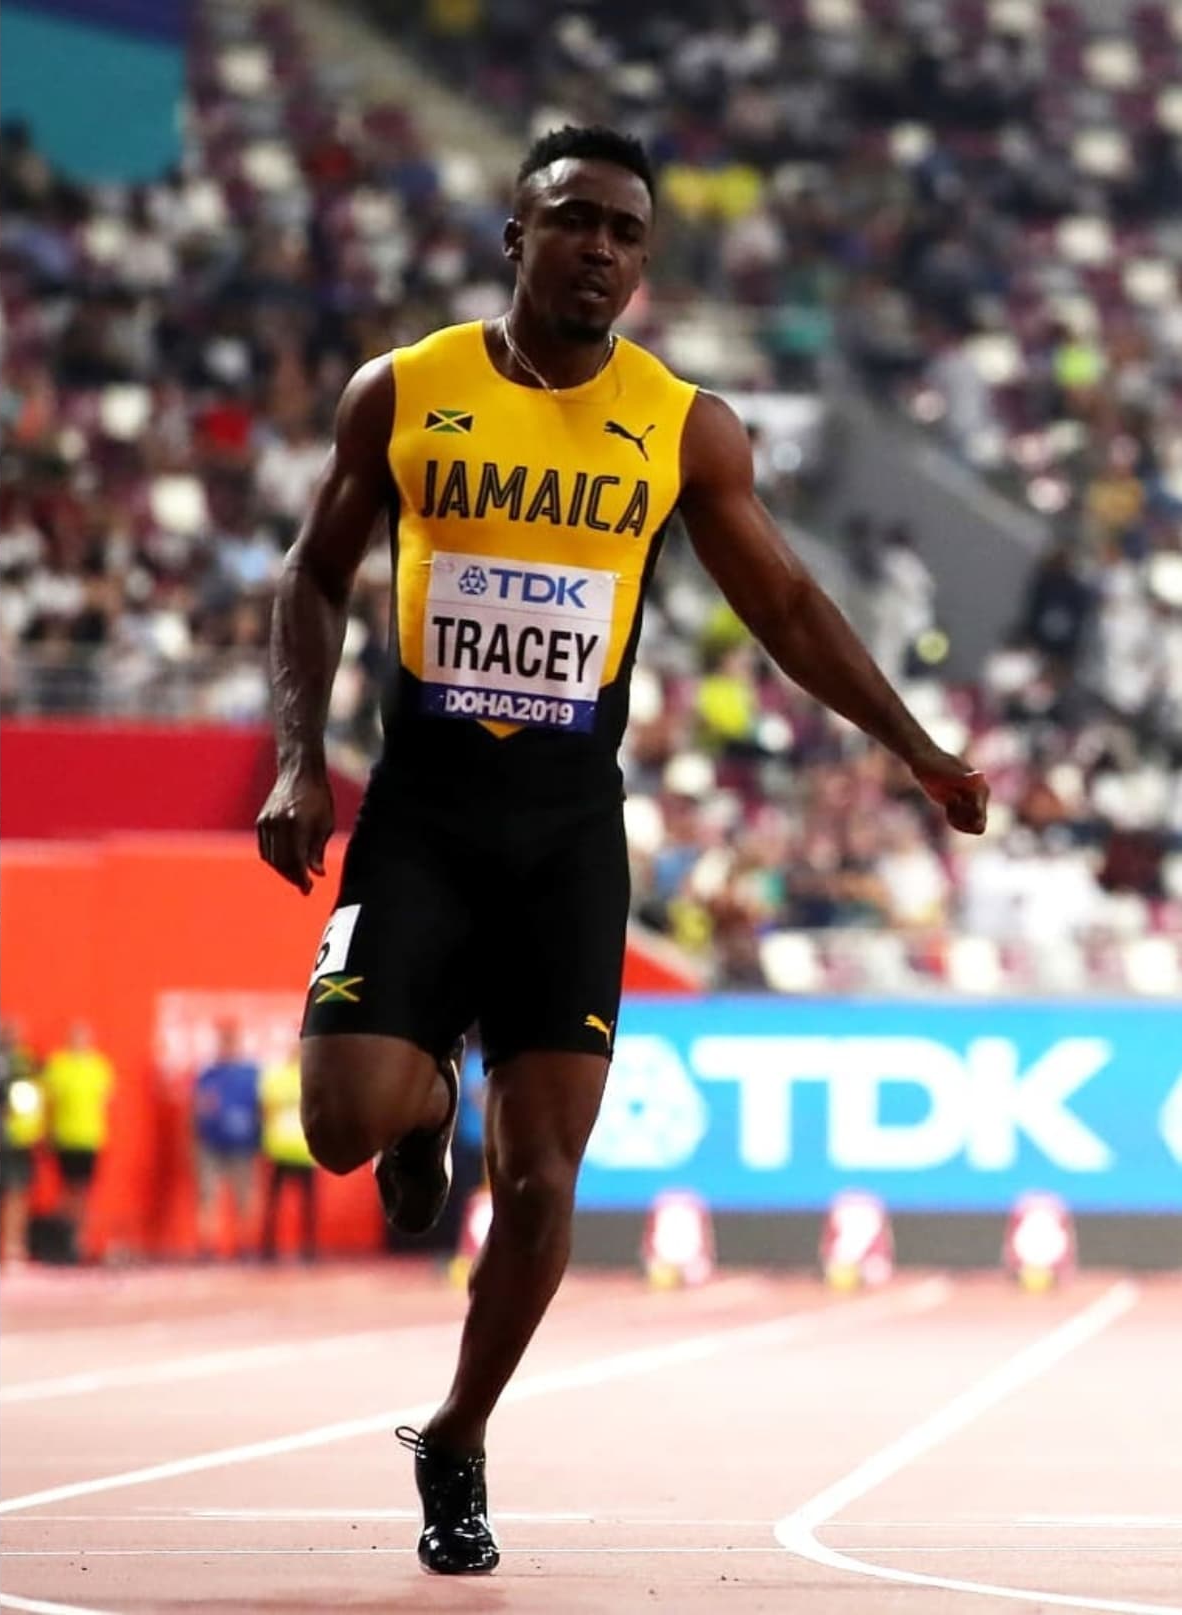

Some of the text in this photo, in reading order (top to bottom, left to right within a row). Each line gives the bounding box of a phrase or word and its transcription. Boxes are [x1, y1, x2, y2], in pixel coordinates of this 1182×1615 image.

[420, 459, 650, 538] JAMAICA
[489, 567, 589, 609] TDK
[432, 615, 599, 684] TRACEY
[445, 689, 575, 726] DOHA2019
[690, 1035, 1113, 1173] TDK
